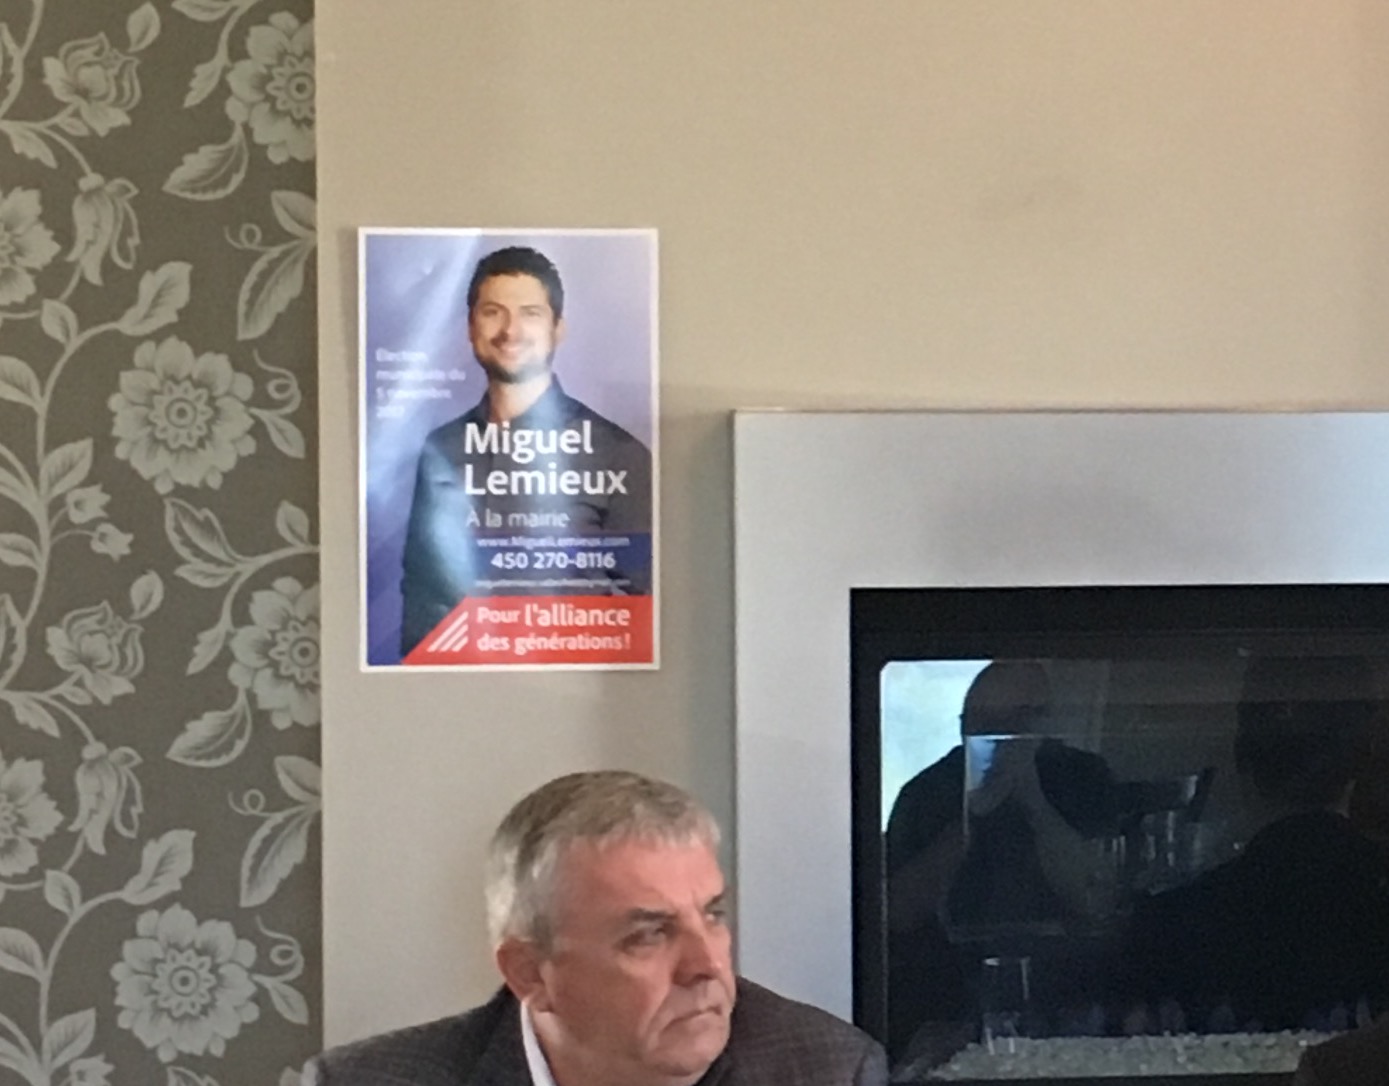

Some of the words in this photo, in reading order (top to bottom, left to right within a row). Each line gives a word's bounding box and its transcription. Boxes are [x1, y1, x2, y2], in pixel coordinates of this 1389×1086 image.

[464, 420, 593, 464] Miguel
[464, 463, 628, 496] Lemieux
[485, 508, 502, 528] la
[508, 508, 570, 528] mairie
[491, 552, 528, 569] 450
[533, 552, 616, 569] 270-8116
[477, 606, 521, 624] Pour
[524, 603, 630, 627] l'alliance
[477, 633, 510, 651] des
